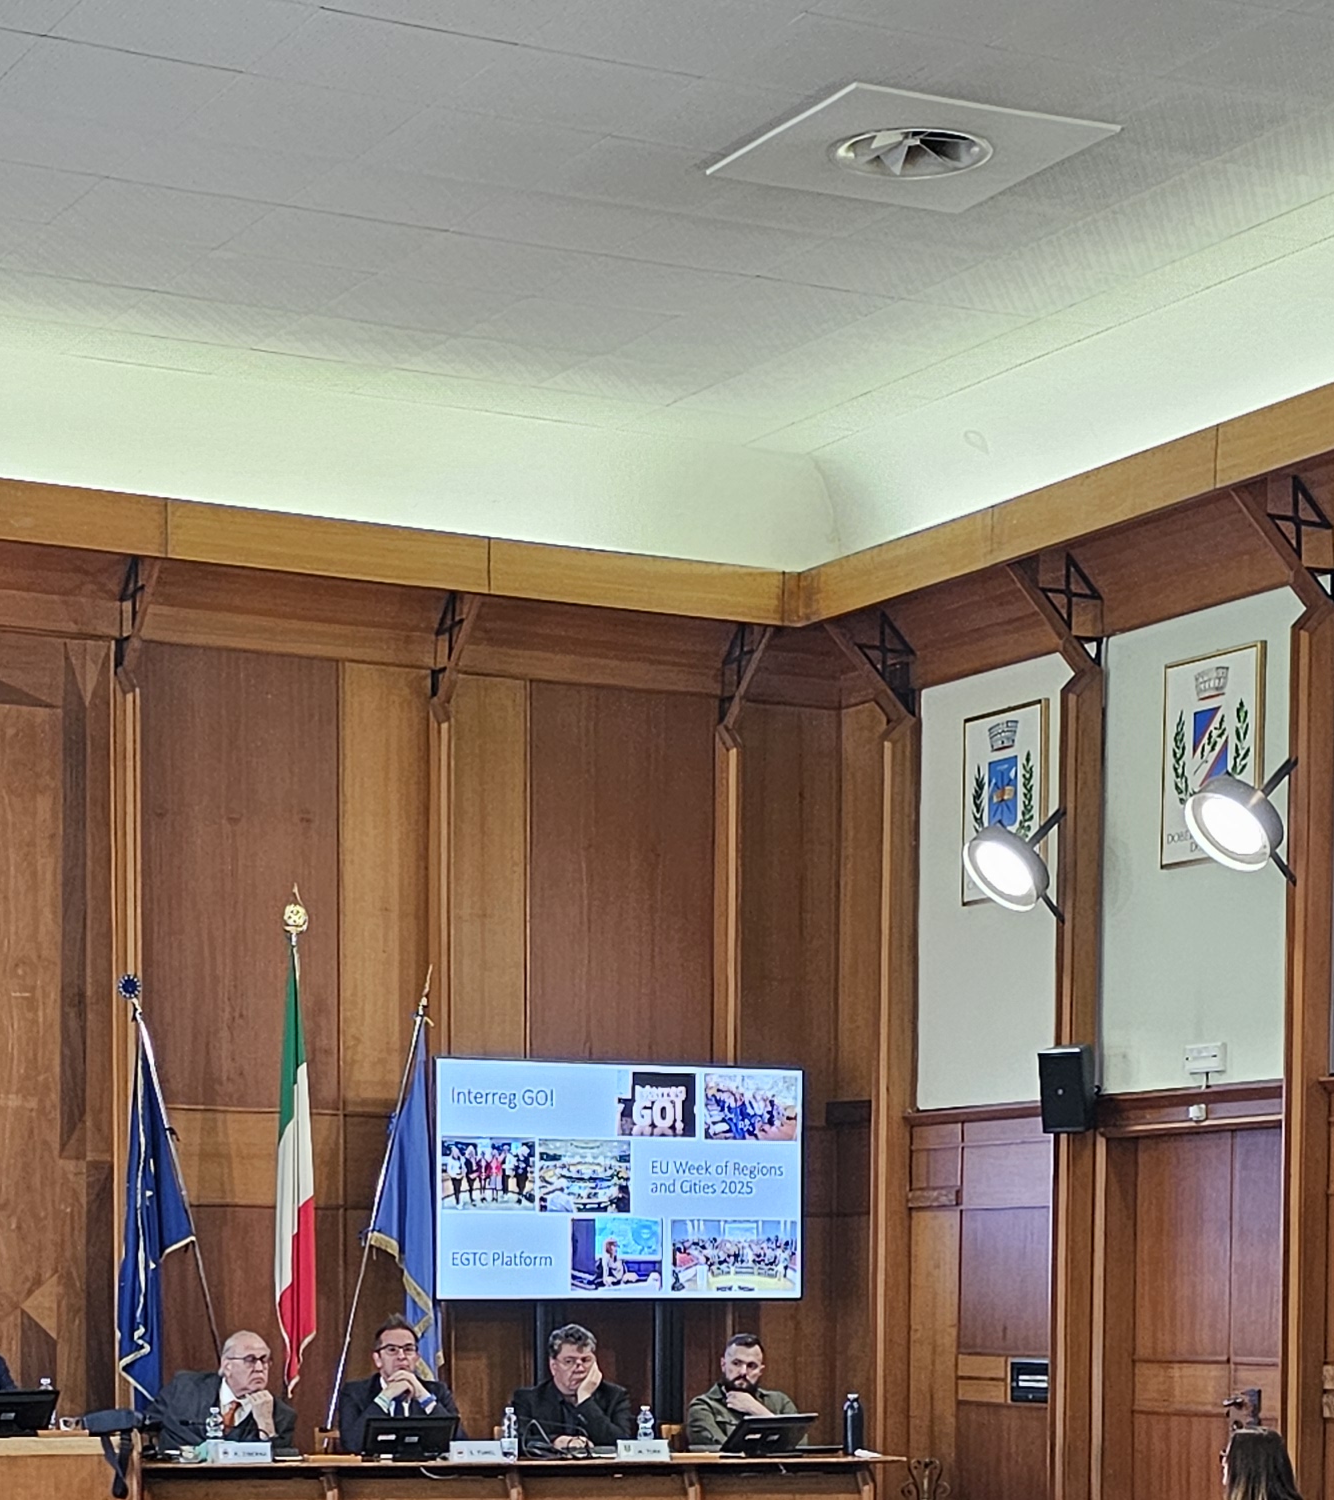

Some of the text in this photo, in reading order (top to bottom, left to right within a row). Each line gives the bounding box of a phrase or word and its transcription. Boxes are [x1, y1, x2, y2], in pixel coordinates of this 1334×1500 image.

[451, 1087, 555, 1109] Interreg GO!
[633, 1100, 684, 1130] GO!
[651, 1160, 783, 1179] EU Week of Regions
[650, 1180, 753, 1195] and Cities 2025
[452, 1252, 552, 1267] EGTC Platform
